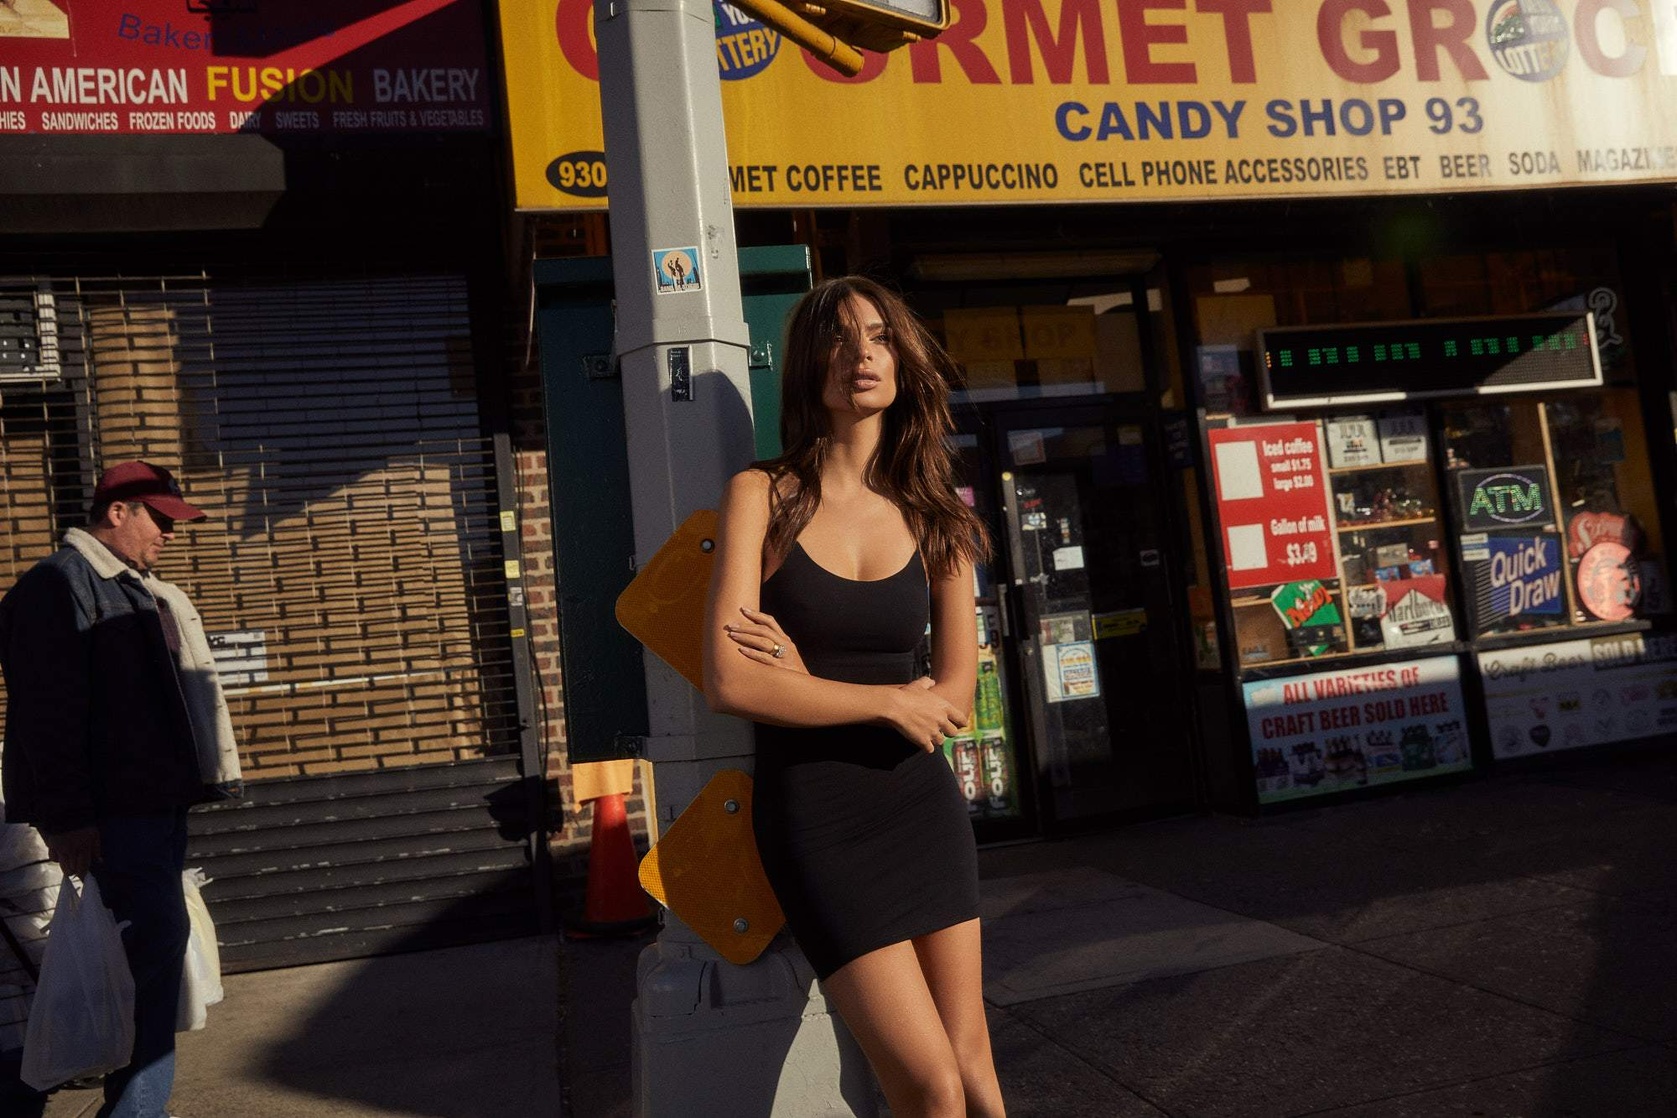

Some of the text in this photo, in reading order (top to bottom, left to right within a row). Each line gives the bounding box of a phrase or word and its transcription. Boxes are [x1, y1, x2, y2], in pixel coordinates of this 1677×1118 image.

[31, 66, 189, 105] AMERICAN
[206, 66, 355, 104] FUSION
[373, 68, 479, 103] BAKERY
[41, 112, 119, 130] SANDWICHES
[129, 112, 174, 130] FROZEN
[177, 112, 216, 130] FOODS
[229, 112, 261, 130] DAIRY
[275, 111, 320, 129] SWEETS
[333, 111, 368, 128] FRESH
[370, 111, 407, 128] FRUITS
[410, 112, 419, 127] &
[420, 109, 485, 127] VEGETABLES
[1055, 96, 1485, 142] CANDY SHOP 93
[728, 164, 777, 192] MET
[786, 163, 882, 192] COFFEE
[904, 163, 1059, 191] CAPPUCCINO
[1079, 162, 1135, 188] CELL
[1143, 160, 1217, 186] PHONE
[1225, 157, 1369, 185] ACCESSORIES
[1384, 156, 1421, 181] EBT
[1441, 154, 1493, 178] BEER
[1509, 151, 1561, 175] SODA
[1469, 482, 1543, 516] ATM
[1490, 536, 1548, 588] Quick
[1509, 570, 1562, 617] Draw
[1283, 667, 1420, 705] ALL VARIETIES OF
[1261, 692, 1449, 740] CRAFT BEER SOLD HERE
